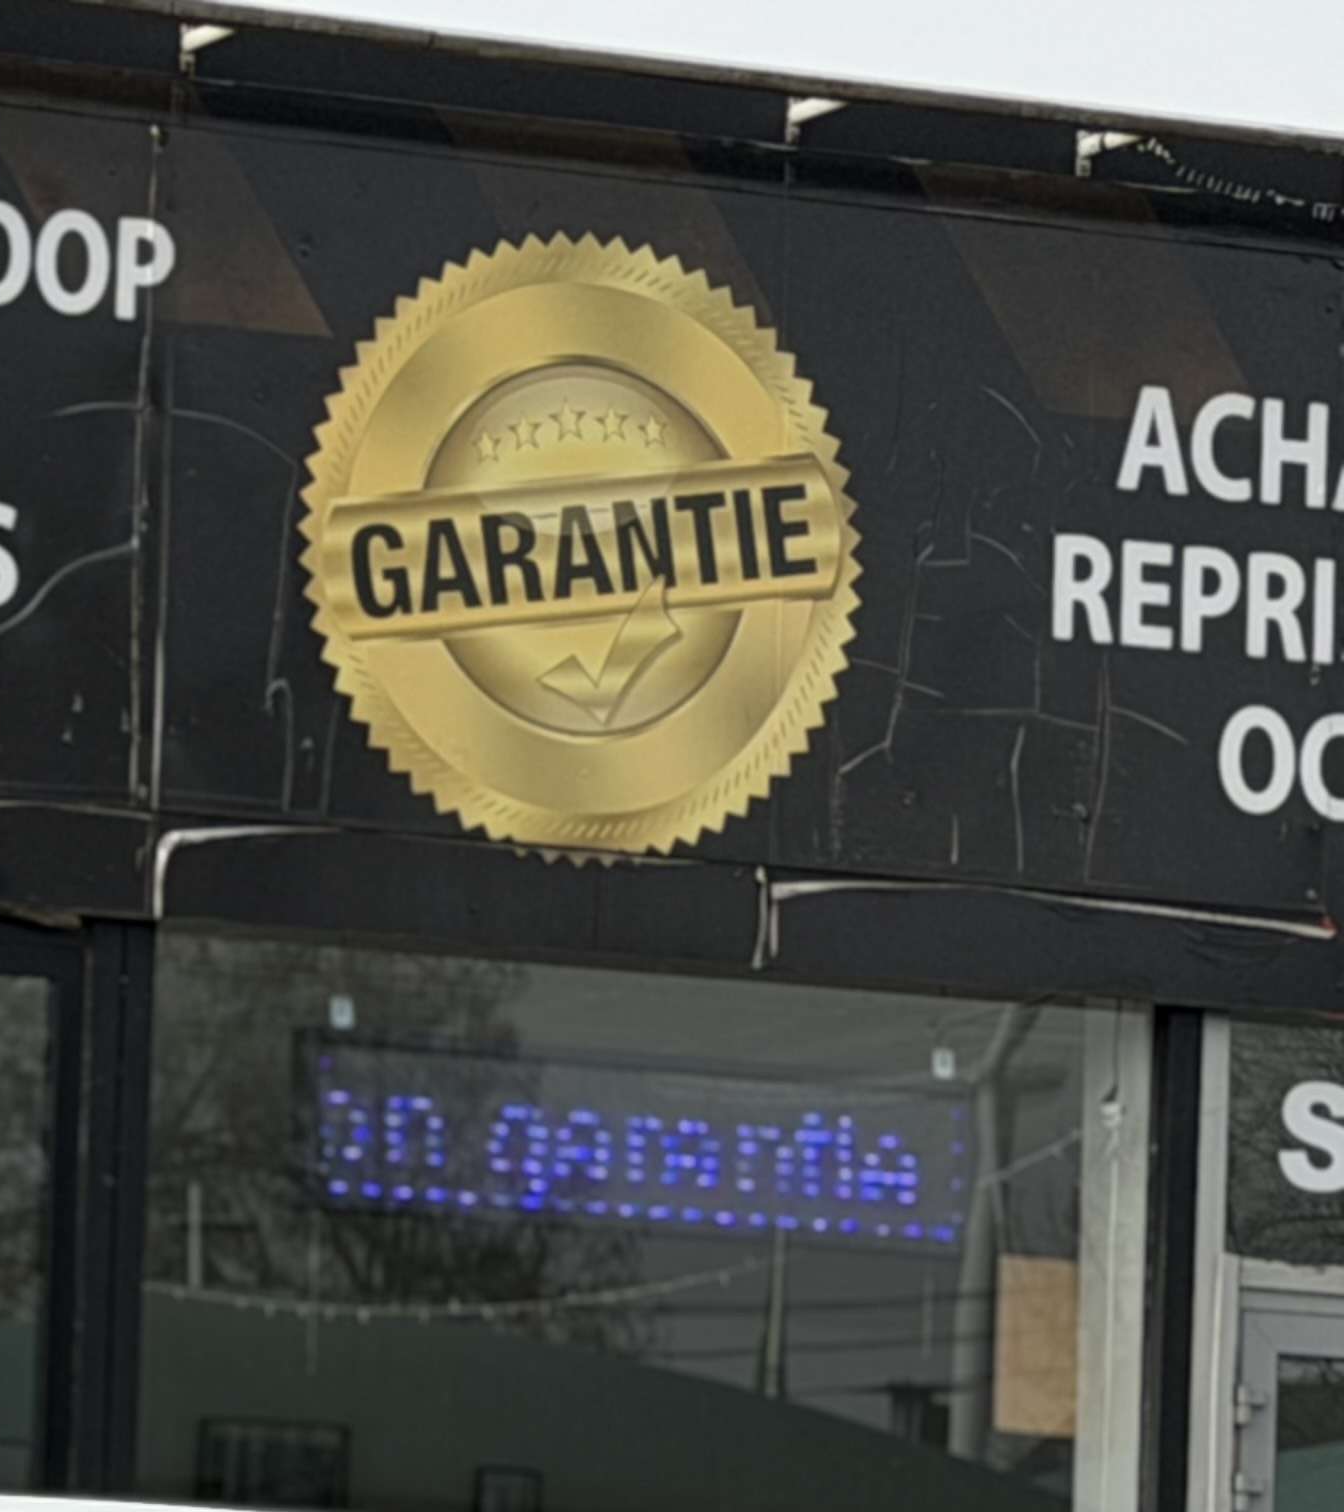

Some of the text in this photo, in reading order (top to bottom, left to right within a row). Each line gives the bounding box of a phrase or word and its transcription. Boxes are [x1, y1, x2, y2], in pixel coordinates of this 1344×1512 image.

[1116, 384, 1344, 512] ACH
[350, 484, 818, 618] GARANTIE
[1052, 533, 1344, 665] REPRI
